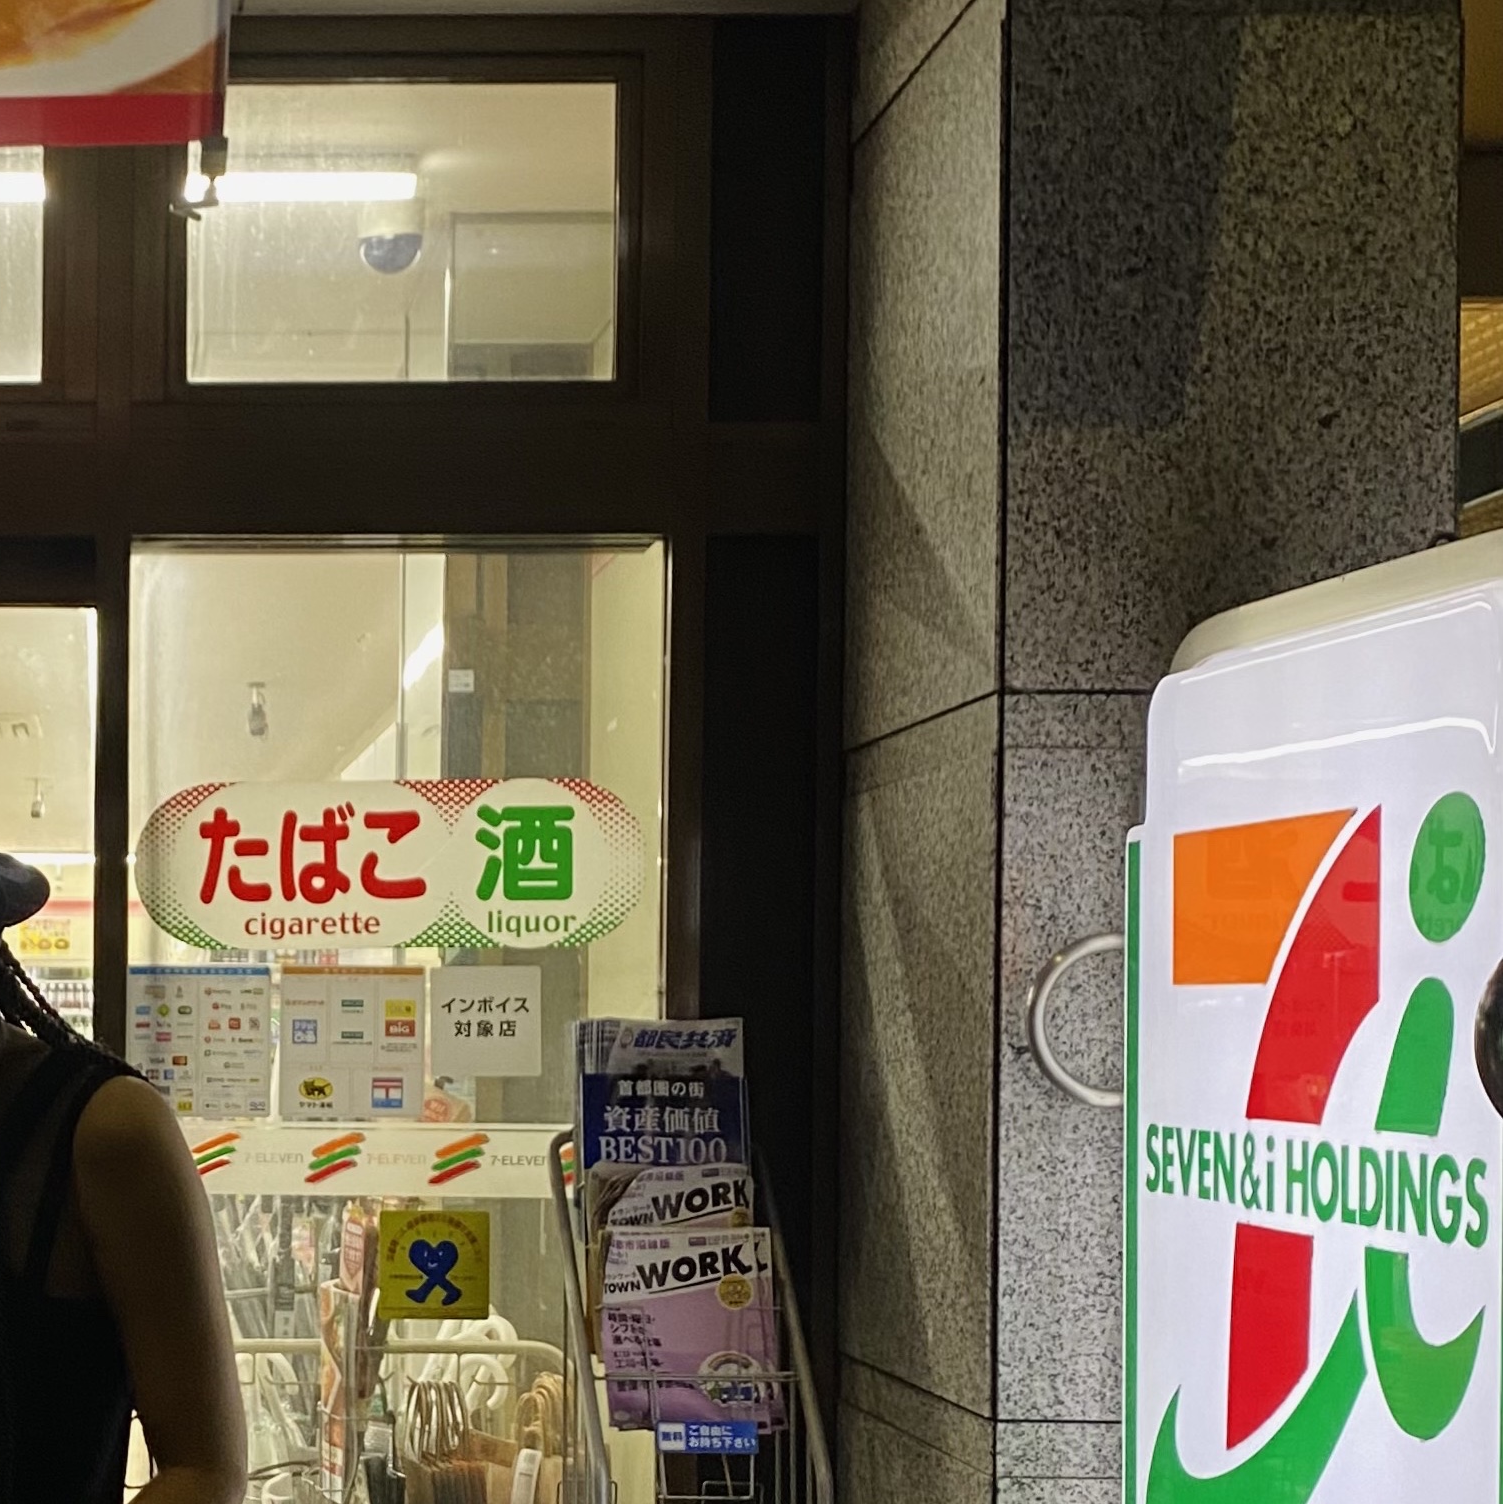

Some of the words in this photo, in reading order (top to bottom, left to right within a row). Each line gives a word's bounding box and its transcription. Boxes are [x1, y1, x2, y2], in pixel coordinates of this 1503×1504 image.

[199, 802, 427, 905] たばこ
[475, 804, 575, 901] 酒
[244, 911, 381, 939] cigarette
[487, 911, 577, 938] liquor
[440, 997, 530, 1014] インボイス
[454, 1021, 517, 1038] 対象店
[634, 1028, 737, 1048] 都民共済
[617, 1079, 704, 1098] 首都圏の街
[604, 1105, 721, 1134] 資産価値
[599, 1136, 727, 1164] BEST100
[652, 1179, 750, 1220] WORK
[1146, 1123, 1275, 1213] SEVEN&i
[1286, 1139, 1490, 1249] HOLDINGS
[636, 1243, 753, 1289] WORK
[661, 1431, 683, 1442] 無料
[688, 1425, 733, 1436] ご自由に
[688, 1436, 757, 1449] お持ち下さい
